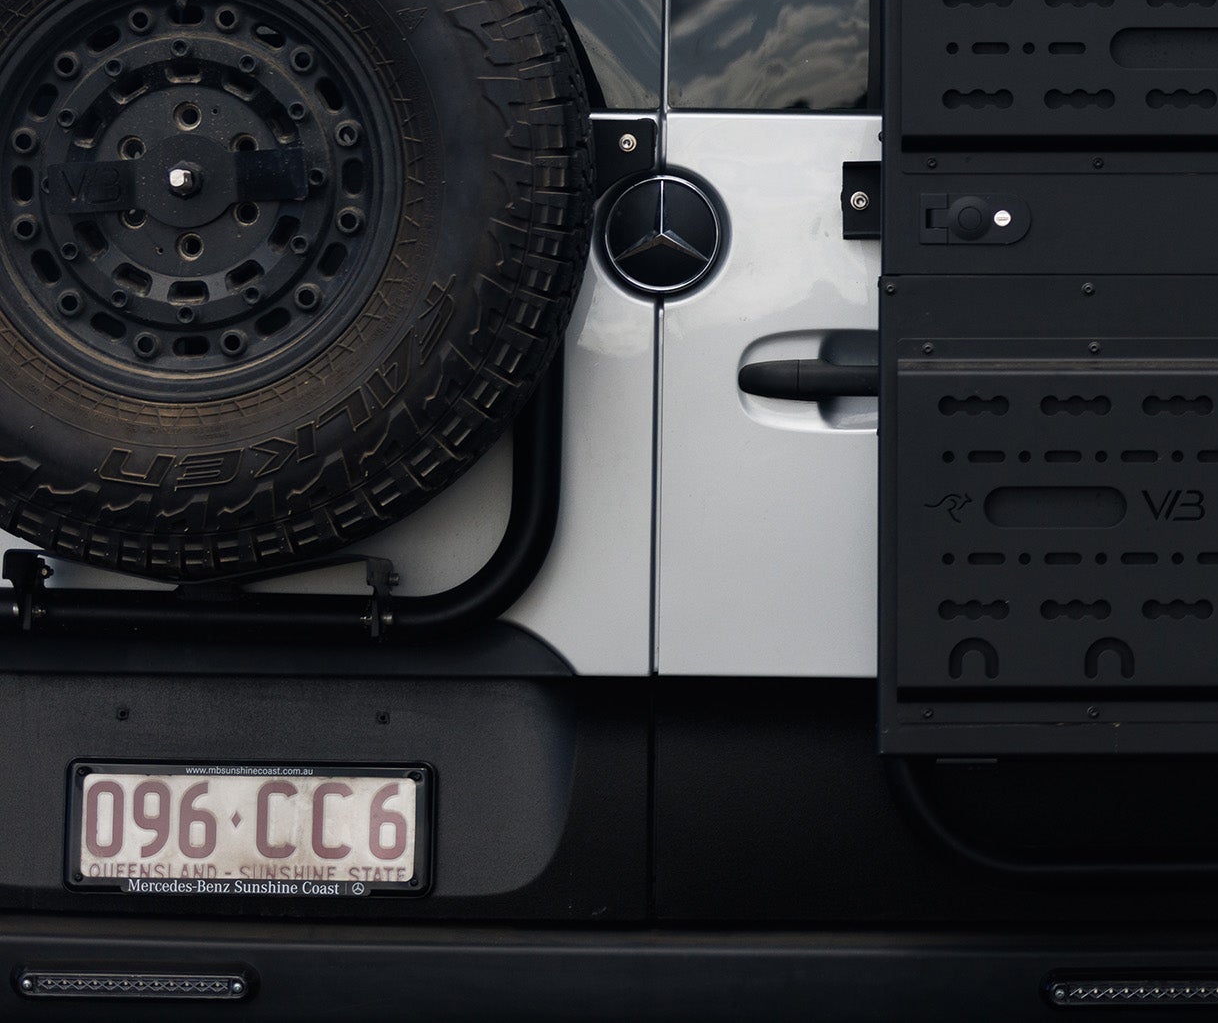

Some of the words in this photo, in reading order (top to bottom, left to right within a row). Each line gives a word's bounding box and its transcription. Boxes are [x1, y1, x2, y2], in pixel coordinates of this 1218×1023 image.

[99, 275, 456, 491] FALKEN
[185, 766, 314, 776] www.mbsunshinecoast.com.au
[89, 862, 217, 879] QUEENSLAND
[239, 864, 337, 880] SUNSHINE
[349, 866, 406, 882] STATE
[127, 878, 231, 893] Mercedes-Benz
[234, 880, 298, 895] Sunshine
[302, 881, 340, 895] Coast
